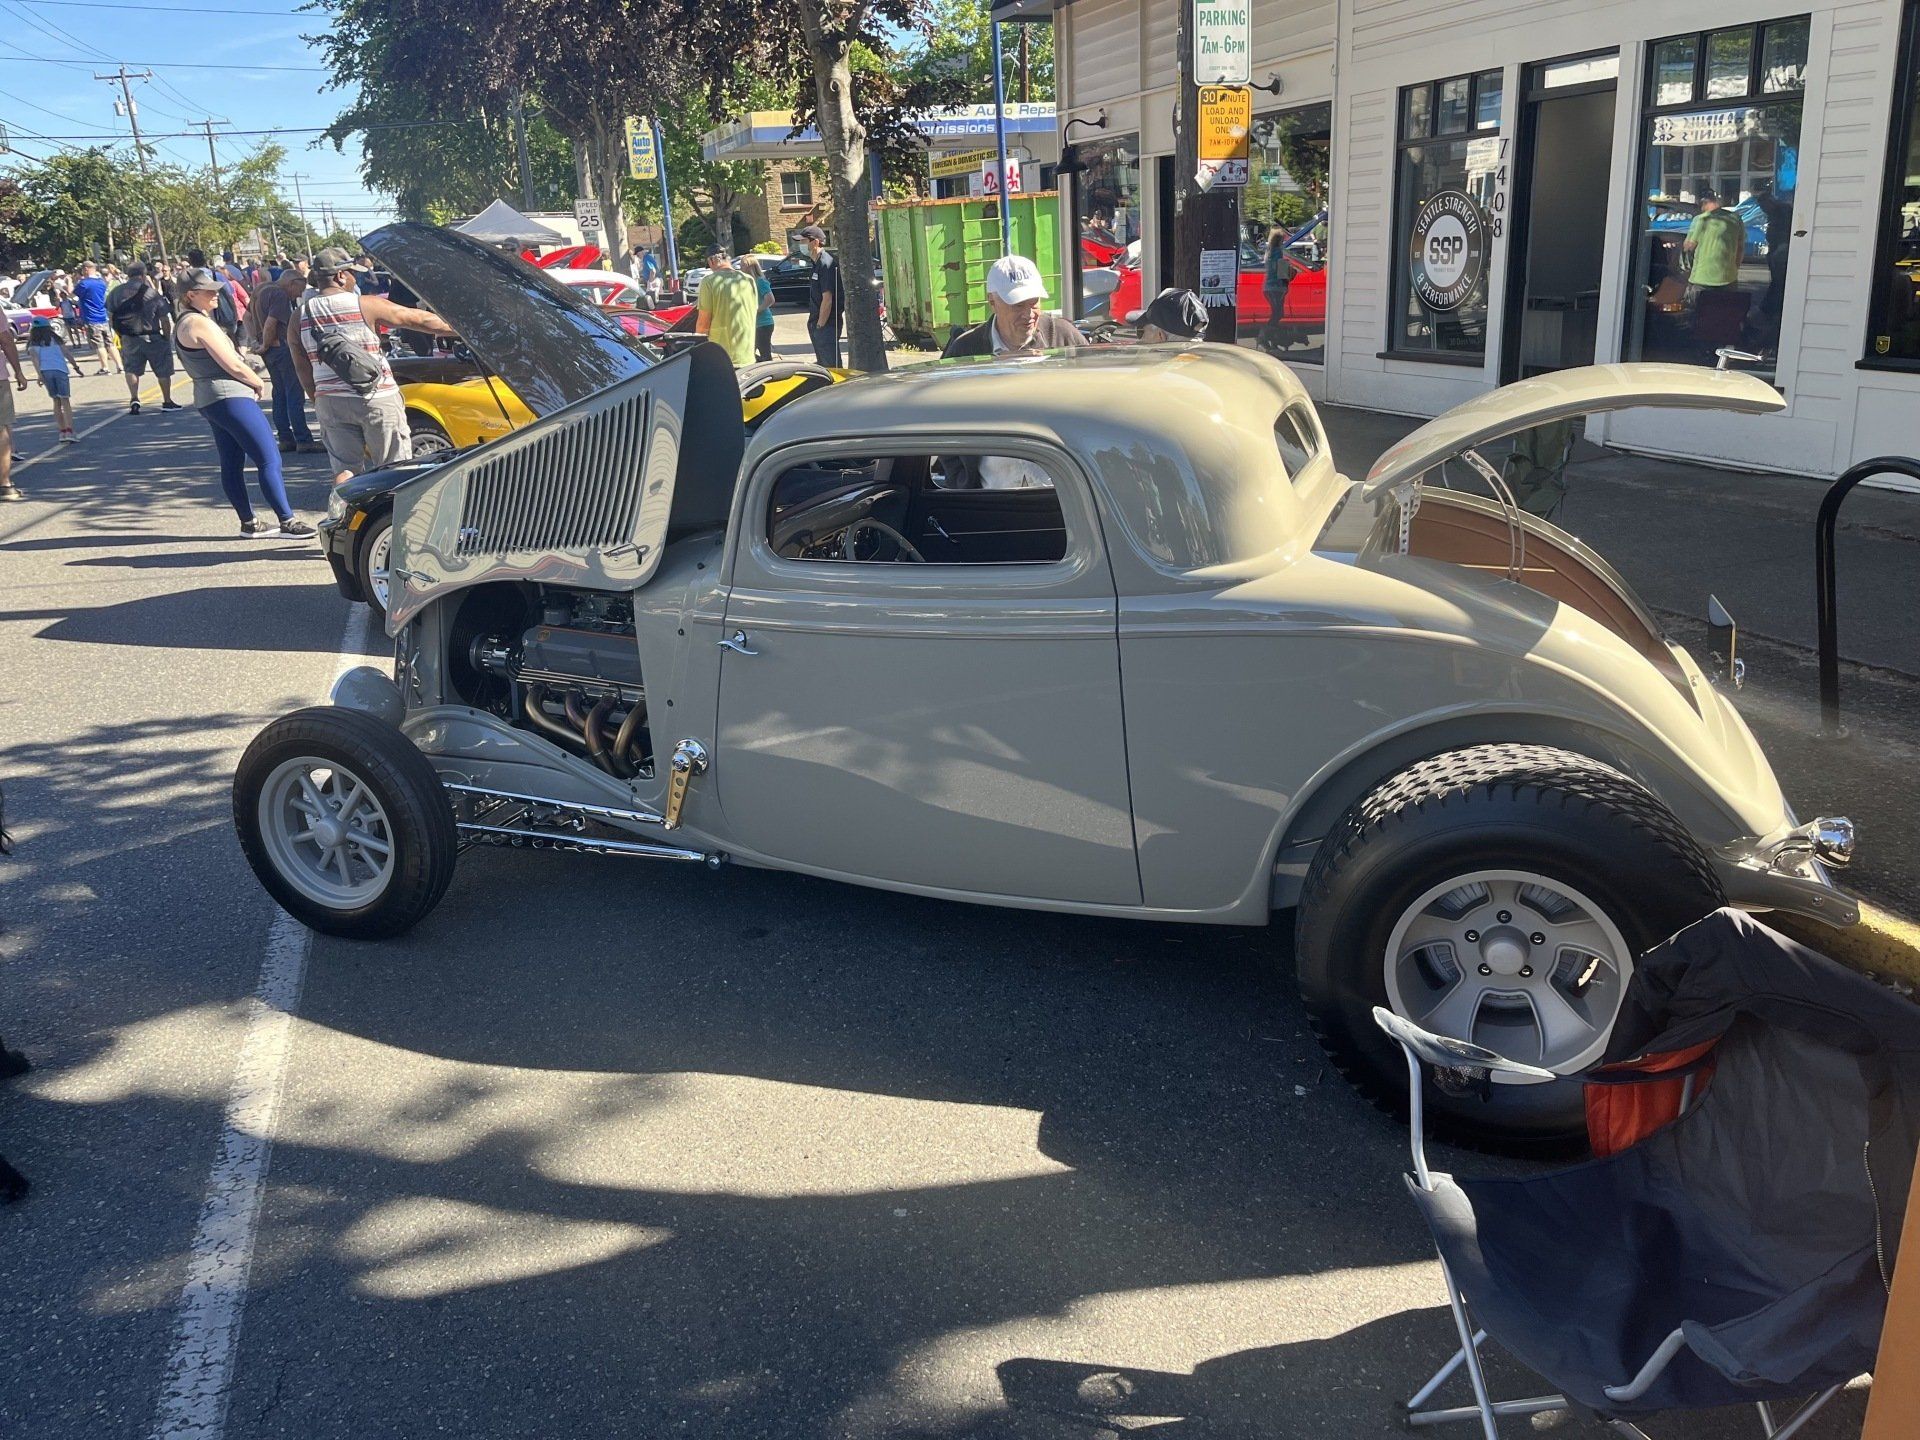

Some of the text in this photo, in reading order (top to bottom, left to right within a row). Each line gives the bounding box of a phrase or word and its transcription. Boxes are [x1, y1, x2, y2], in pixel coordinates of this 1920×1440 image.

[1199, 9, 1246, 26] PARKING
[1200, 34, 1245, 54] 7AM-6PM
[1202, 91, 1216, 103] 30
[975, 104, 1013, 116] Auo
[1019, 103, 1056, 117] Repa
[1205, 107, 1244, 116] LOAD AND
[1209, 116, 1240, 125] UNLOAD
[632, 136, 651, 148] Auto
[580, 215, 600, 228] 25
[1417, 196, 1478, 236] SEATTLE STRENGTH
[1429, 236, 1463, 265] SSP
[1422, 273, 1473, 306] PERFORMANCE
